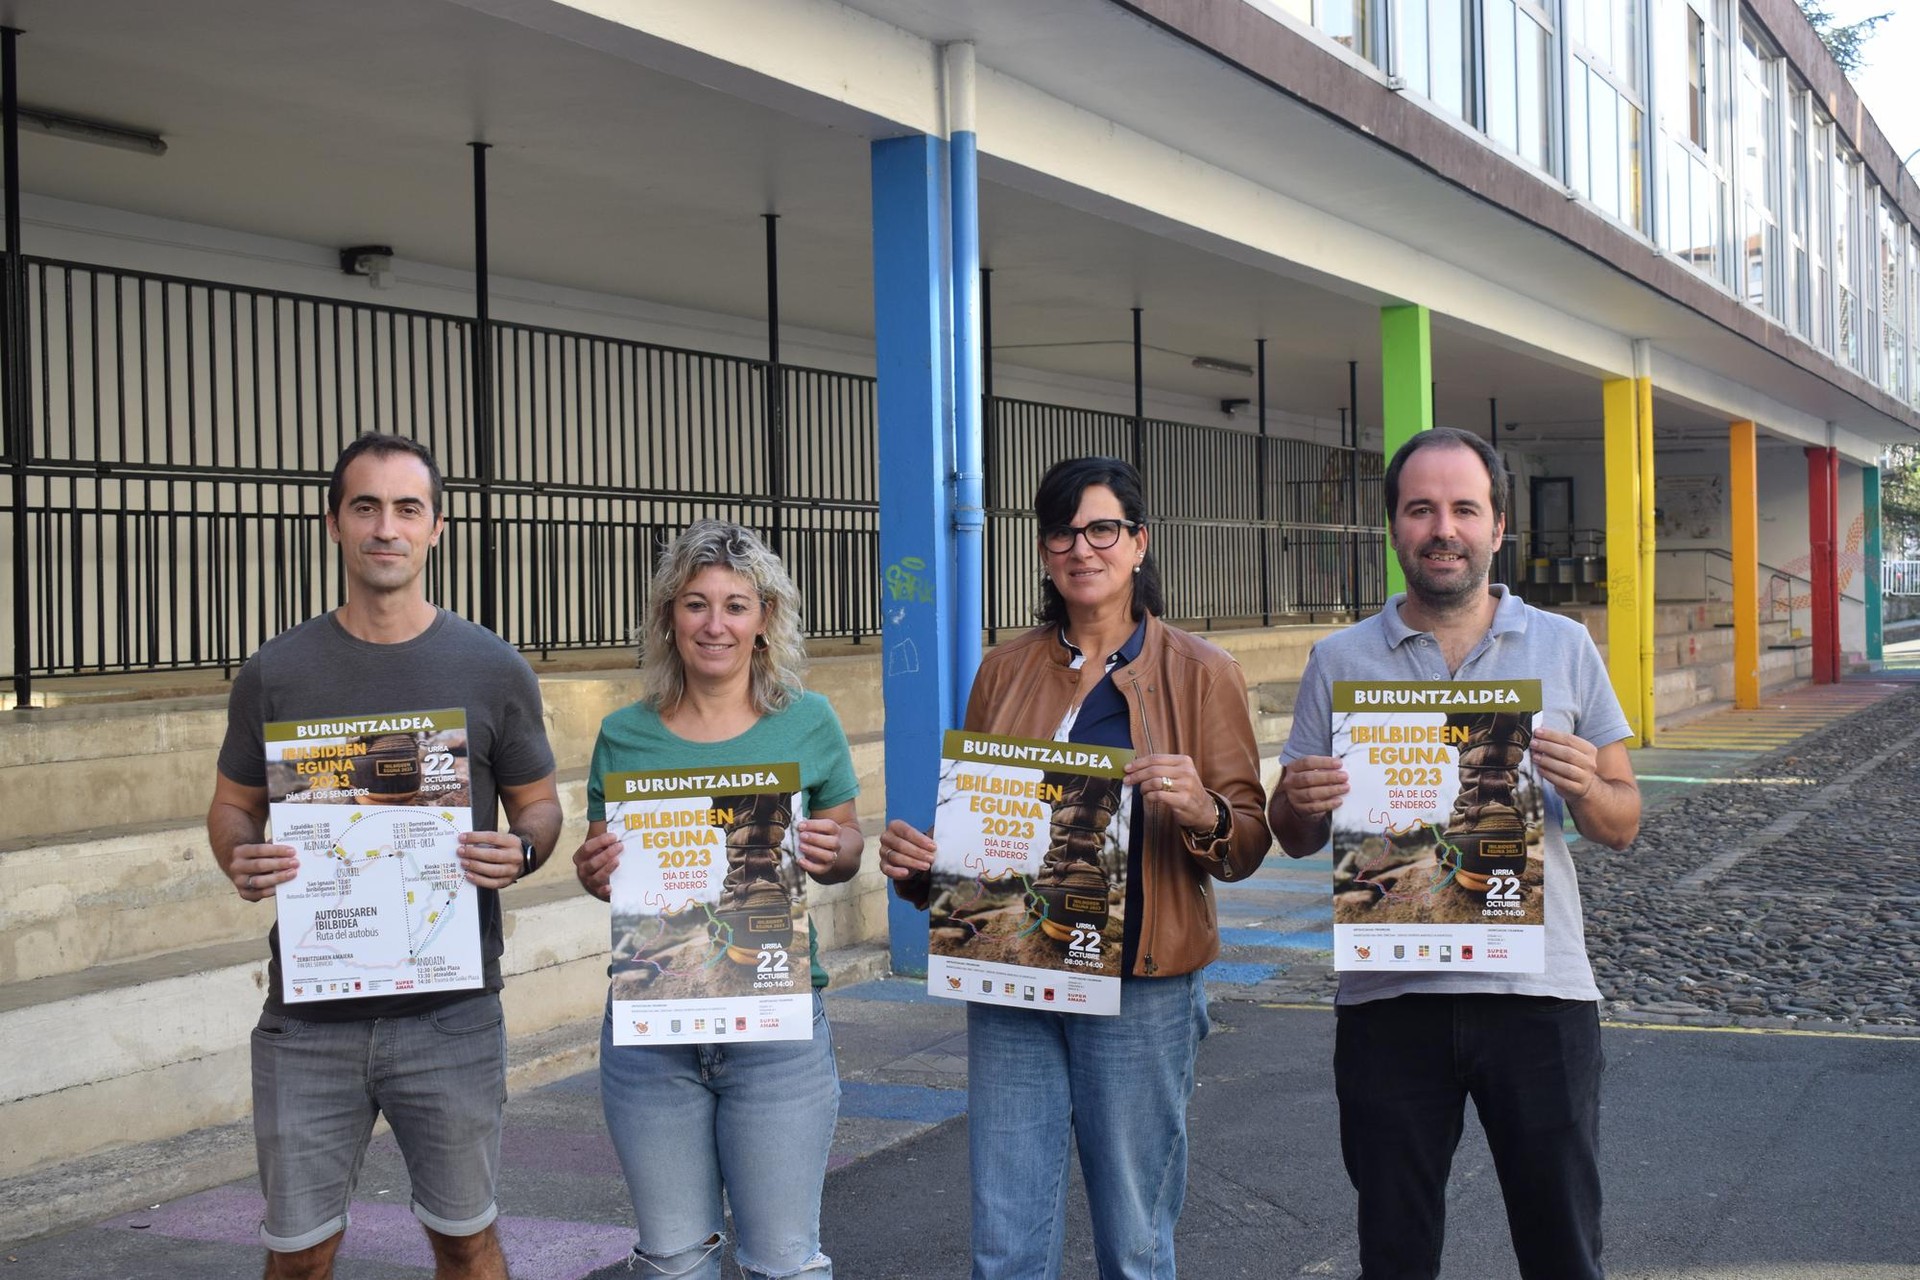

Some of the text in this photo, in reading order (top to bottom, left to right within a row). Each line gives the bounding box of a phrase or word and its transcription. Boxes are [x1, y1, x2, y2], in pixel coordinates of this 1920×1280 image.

[1354, 689, 1520, 704] BURUNTZALDEA
[297, 717, 434, 737] BURUNTZALDEA
[1351, 726, 1470, 744] IBILBIDEEN
[282, 742, 367, 760] IBILBIDEEN
[963, 740, 1113, 770] BURUNTZALDEA
[1369, 747, 1450, 764] EGUNA
[297, 759, 355, 775] EGUNA
[424, 753, 455, 775] 22
[309, 774, 350, 789] 2023
[424, 775, 456, 783] OCTUBRE
[625, 772, 780, 794] BURUNTZALDEA
[1384, 768, 1442, 786] 2023
[286, 788, 370, 802] DÍA DE LOS SENDEROS
[421, 783, 461, 792] 08:00-14:00
[956, 774, 1063, 802] IBILBIDEEN
[1389, 788, 1438, 798] DÍA DE LOS
[970, 796, 1044, 819] EGUNA
[1390, 800, 1436, 809] SENDEROS
[624, 808, 735, 830] IBILBIDEEN
[982, 816, 1035, 839] 2023
[642, 829, 718, 849] EGUNA
[984, 837, 1029, 850] DÍA DE LOS
[658, 849, 712, 868] 2023
[984, 849, 1028, 860] SENDEROS
[662, 870, 708, 881] DÍA DE LOS
[664, 880, 708, 891] SENDEROS
[1486, 877, 1520, 900] 22
[1486, 900, 1520, 908] OCTUBRE
[315, 907, 377, 920] AUTOBUSAREN
[316, 919, 358, 930] IBILBIDEA
[1076, 922, 1096, 930] URRIA
[316, 930, 334, 941] Ruta
[335, 928, 347, 940] del
[1069, 930, 1101, 953] 22
[762, 942, 782, 950] URRIA
[756, 950, 789, 973] 22
[1064, 958, 1104, 968] 08:00-14:00
[1068, 951, 1100, 960] OCTUBRE
[757, 972, 790, 980] OCTUBRE
[754, 980, 794, 988] 08:00-14:00
